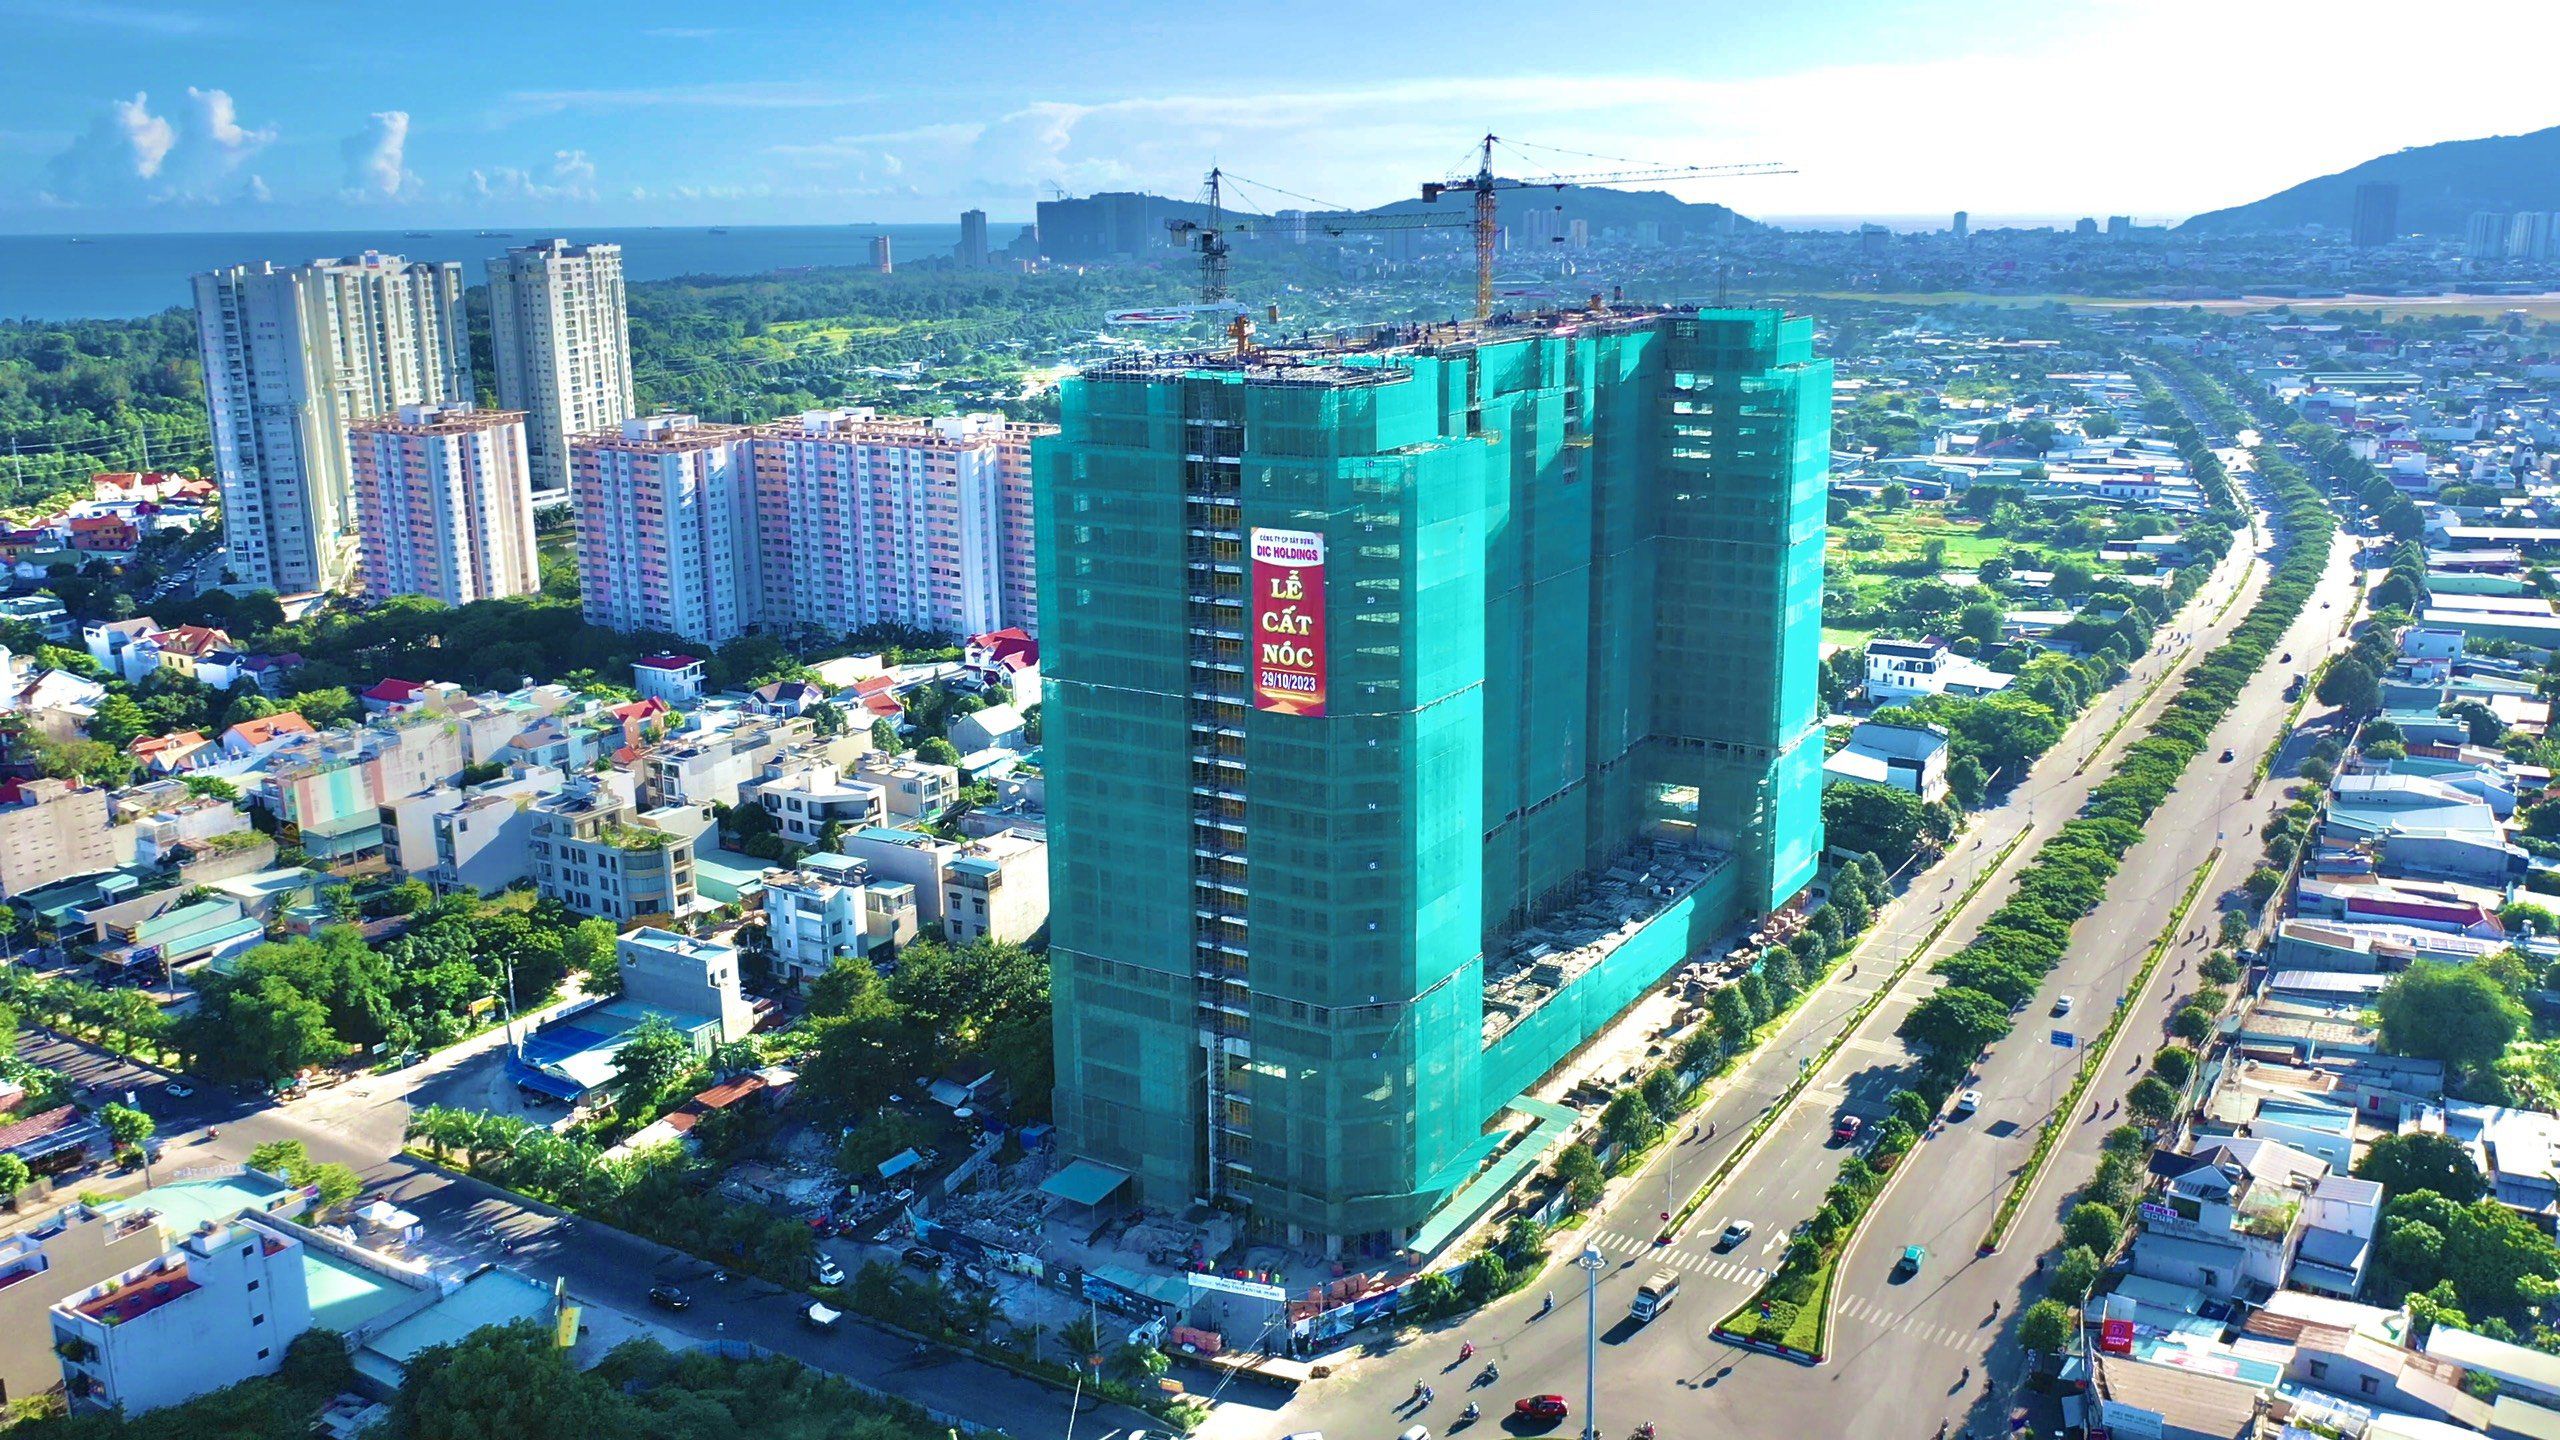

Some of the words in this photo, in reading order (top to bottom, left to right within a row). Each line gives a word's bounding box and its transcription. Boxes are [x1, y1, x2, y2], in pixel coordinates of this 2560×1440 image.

[1257, 545, 1272, 557] DIC
[1274, 546, 1318, 561] HOLDINGS
[1270, 569, 1303, 600] LỄ
[1262, 605, 1312, 636] CẤT
[1262, 640, 1314, 668] NÓC
[1262, 671, 1316, 692] 29/10/2023
